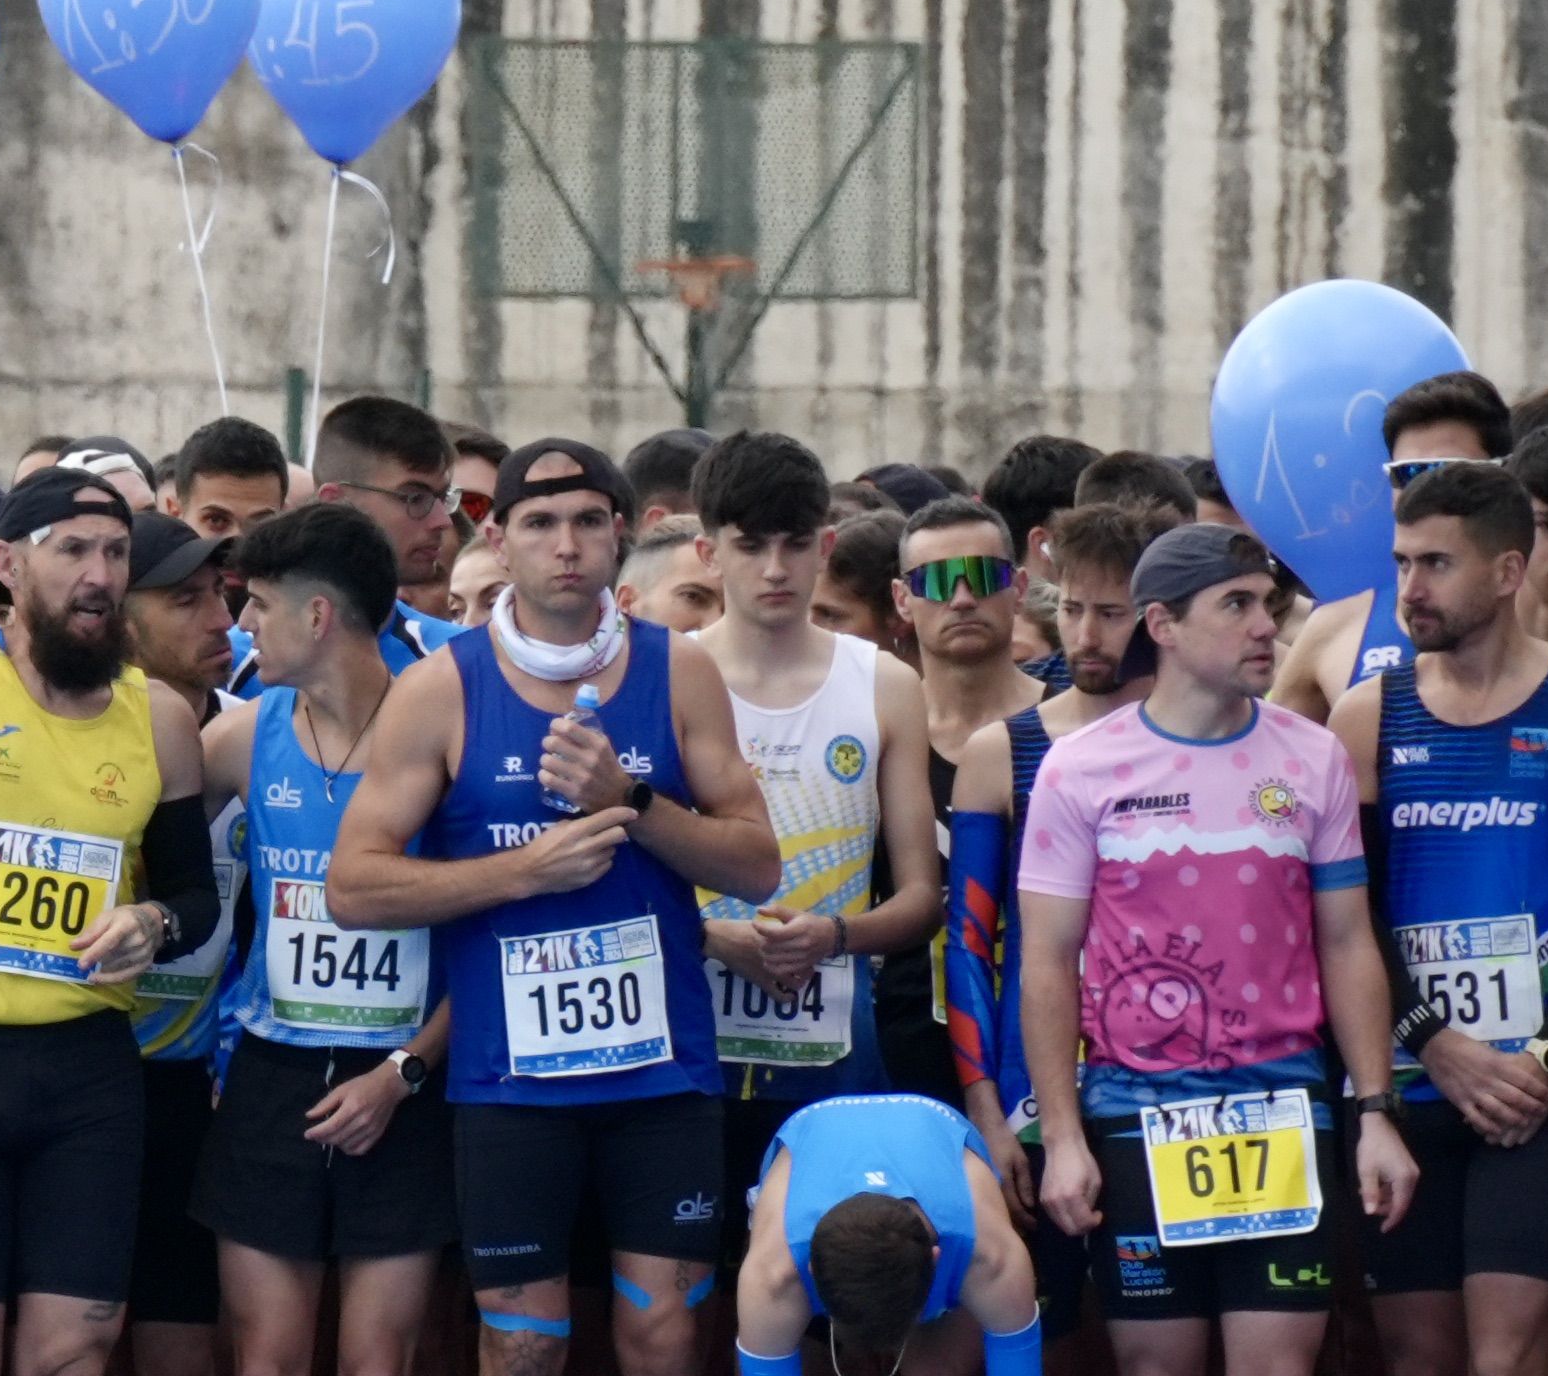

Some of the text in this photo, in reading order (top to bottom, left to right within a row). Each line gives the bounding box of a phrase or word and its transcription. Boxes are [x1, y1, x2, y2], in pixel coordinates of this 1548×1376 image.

[265, 777, 302, 808] als
[1392, 796, 1539, 832] enerplus
[288, 932, 401, 992] 1544
[523, 934, 576, 973] 21K
[528, 971, 642, 1037] 1530
[1167, 1104, 1220, 1142] 21K
[1184, 1137, 1270, 1199] 617
